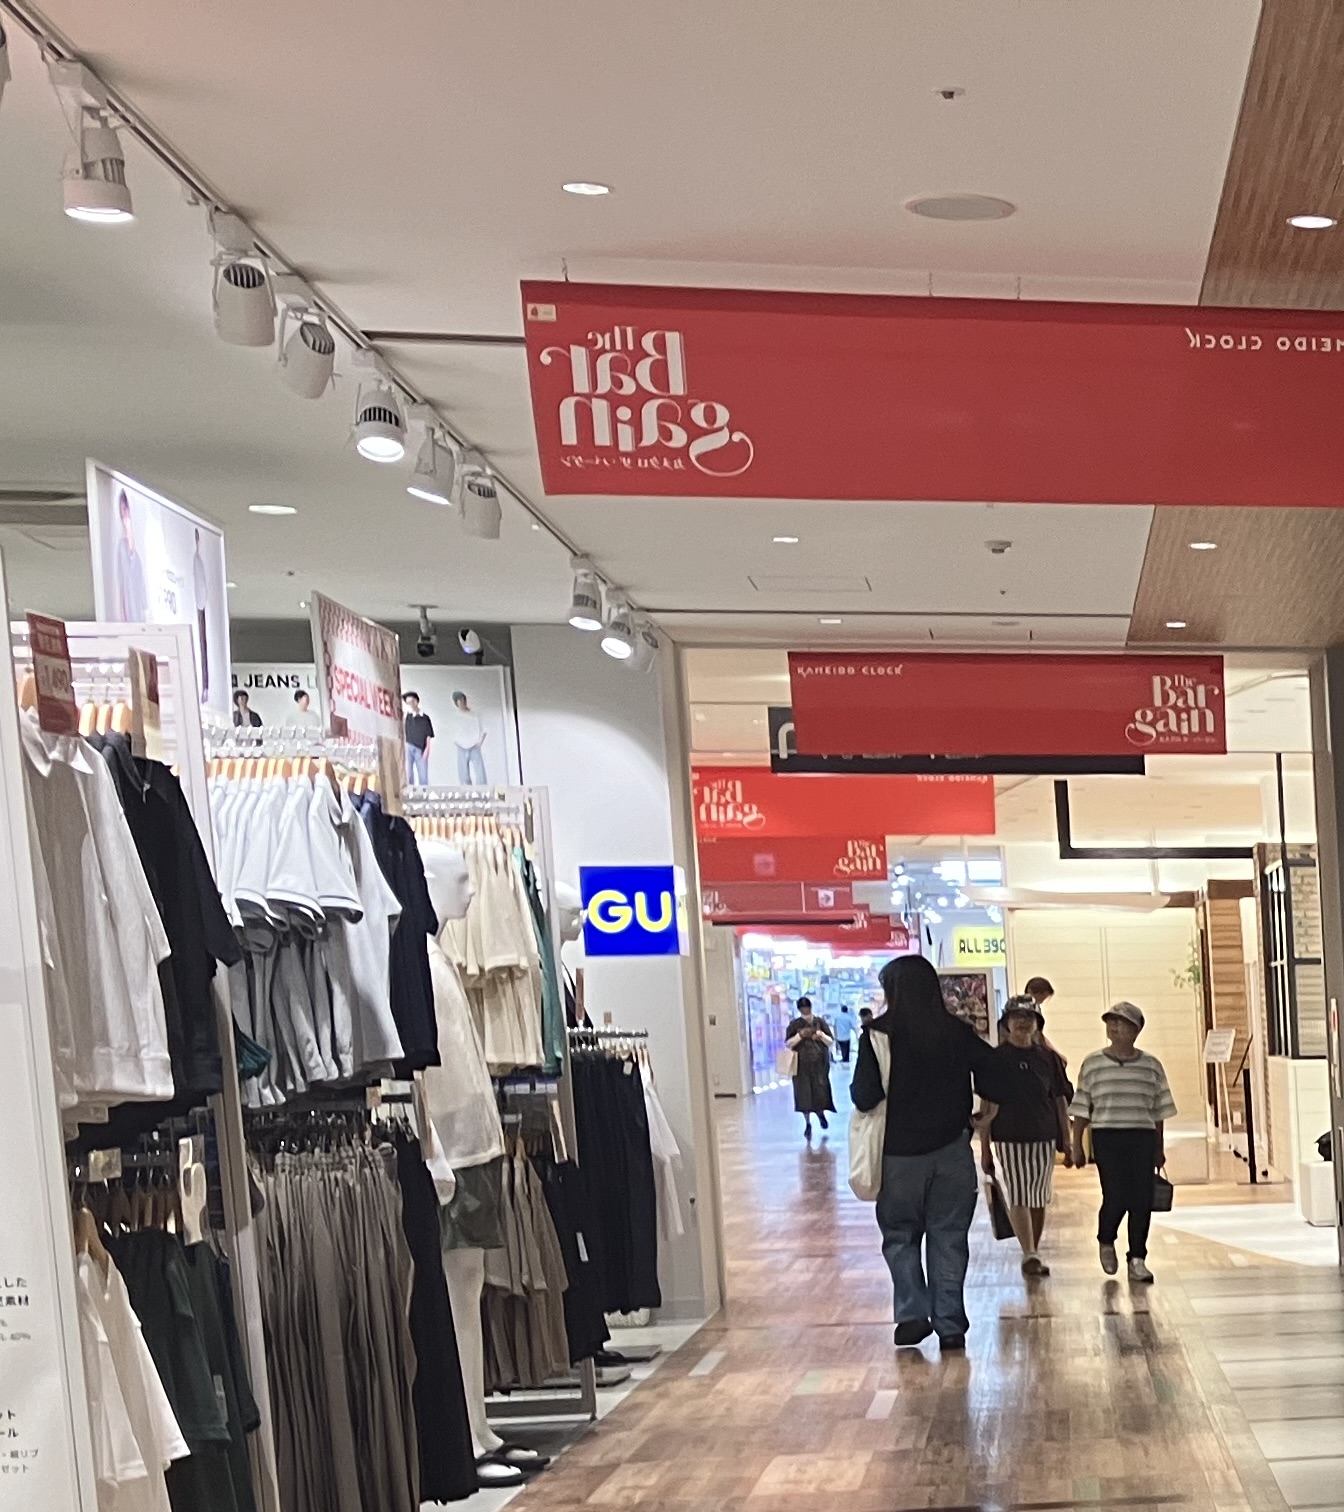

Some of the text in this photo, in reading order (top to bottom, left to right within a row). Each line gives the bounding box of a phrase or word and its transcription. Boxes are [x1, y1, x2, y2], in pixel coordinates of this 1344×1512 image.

[244, 673, 300, 689] JEANS
[797, 664, 904, 678] KAMEIDO CLOCK
[1152, 675, 1219, 708] Bar
[1125, 708, 1215, 747] gain
[588, 889, 673, 934] GU
